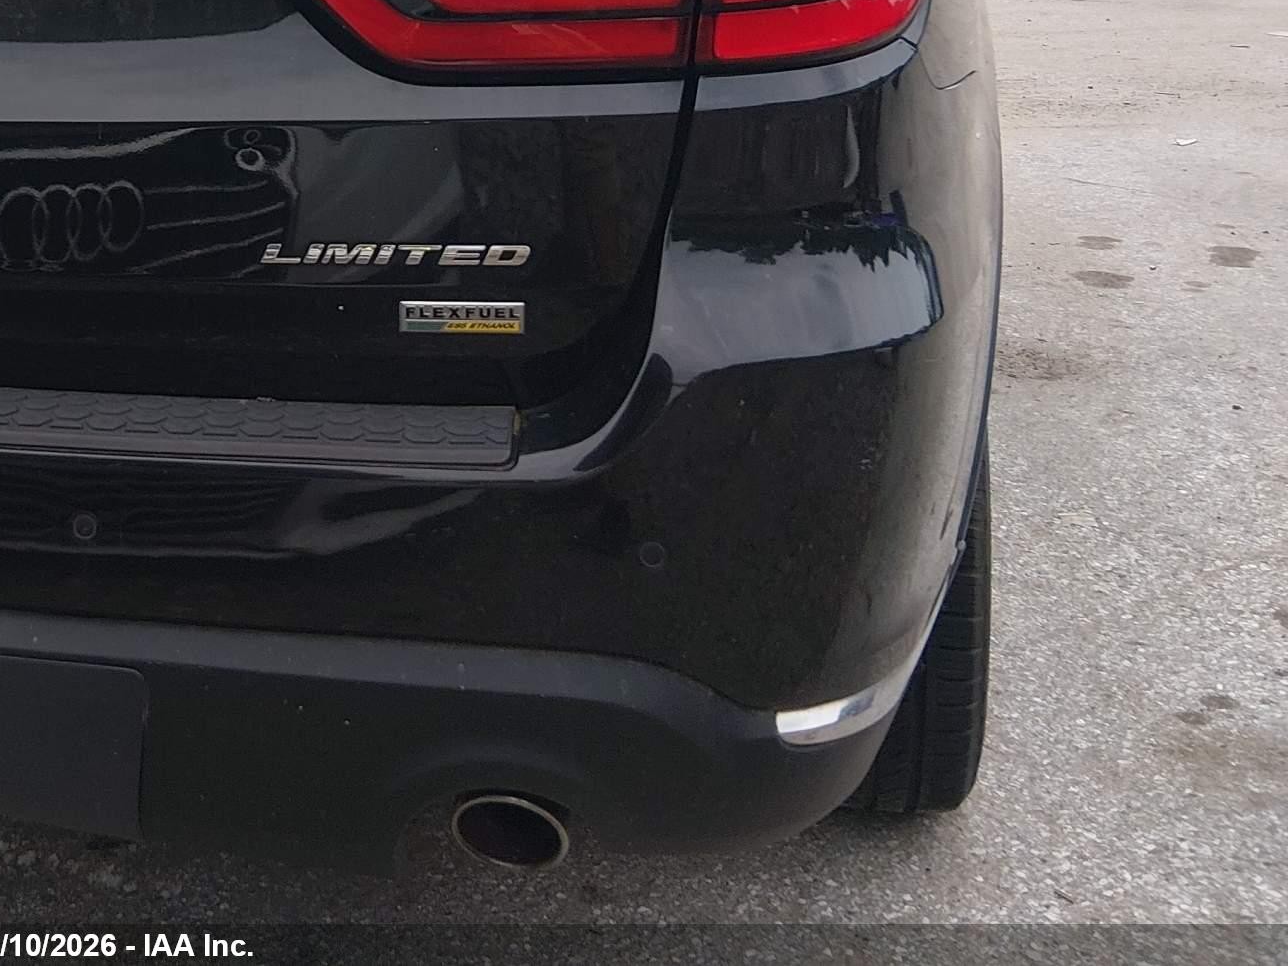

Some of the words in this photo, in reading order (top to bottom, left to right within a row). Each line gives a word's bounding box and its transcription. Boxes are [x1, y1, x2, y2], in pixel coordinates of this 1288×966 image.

[260, 242, 532, 266] LIMITED
[405, 306, 521, 319] FLEXFUEL
[469, 322, 516, 330] ETHANOL
